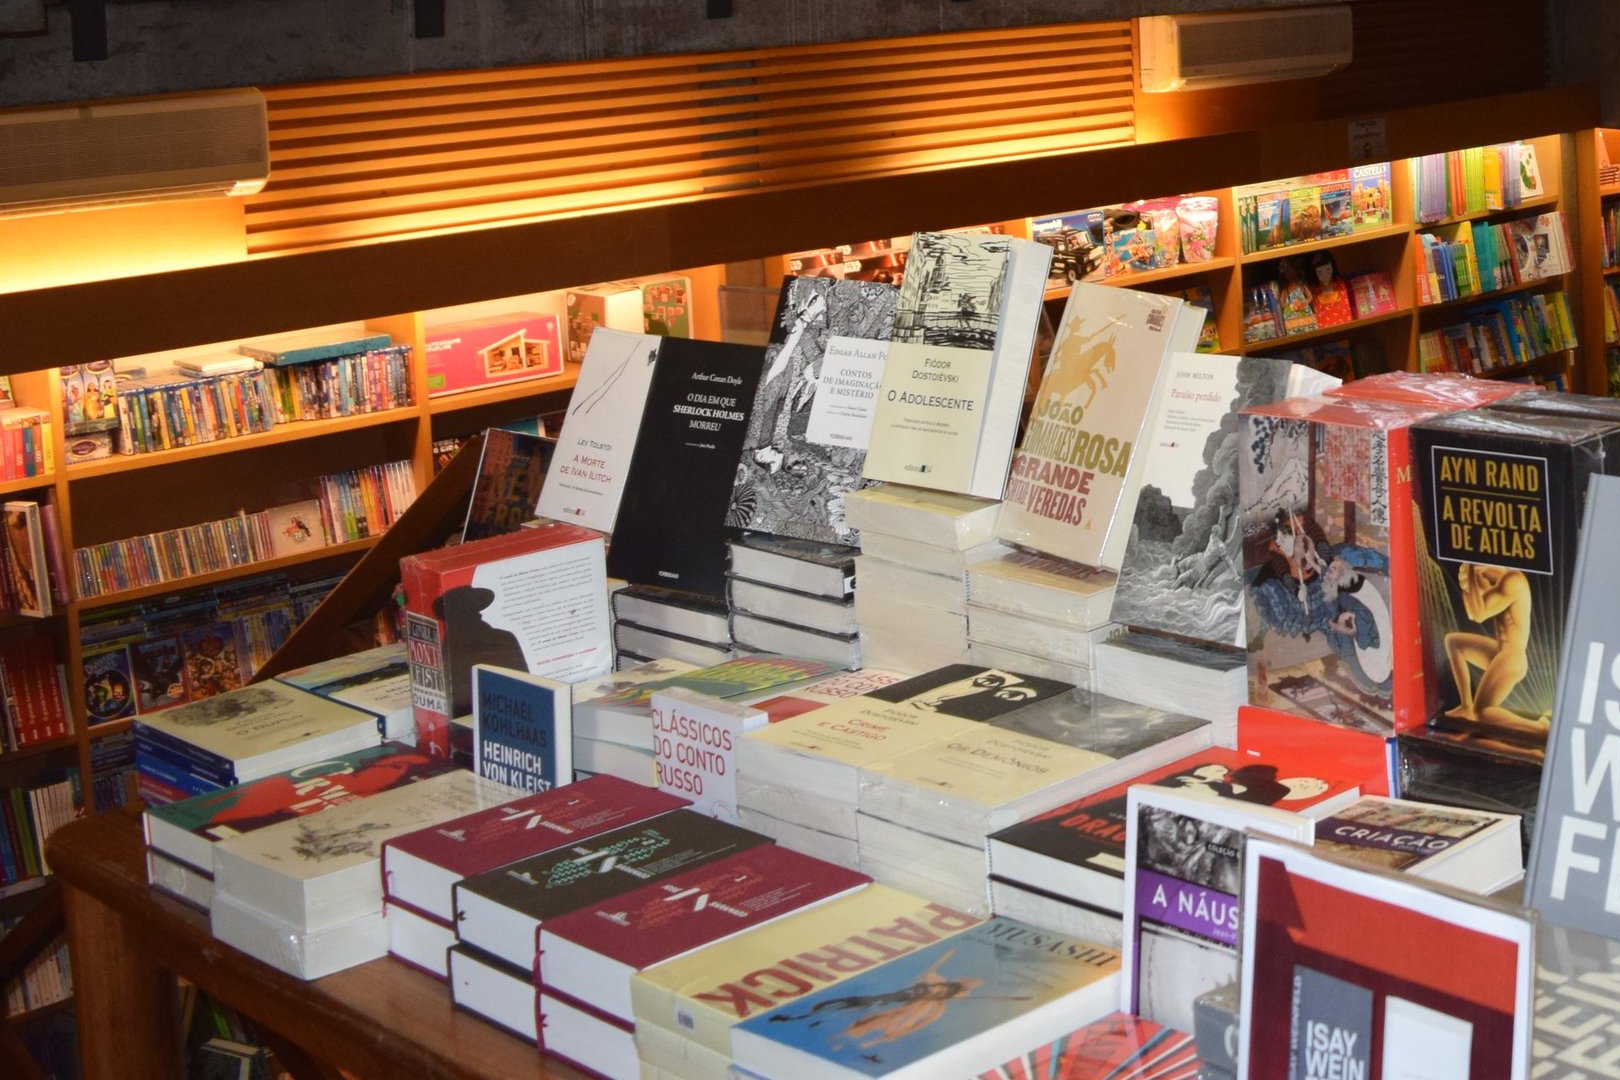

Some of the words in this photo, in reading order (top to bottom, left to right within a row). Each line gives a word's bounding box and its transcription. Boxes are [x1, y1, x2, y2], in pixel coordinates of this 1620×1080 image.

[822, 376, 834, 384] DE
[840, 368, 873, 379] CONTOS
[1175, 371, 1191, 380] JOHN
[1192, 372, 1214, 381] MILTON
[687, 393, 694, 401] O
[694, 394, 707, 403] DIA
[707, 395, 720, 404] EM
[720, 397, 736, 408] QUE
[830, 387, 835, 395] E
[836, 387, 874, 399] MISTÉRIO
[887, 389, 896, 402] O
[900, 391, 974, 411] ADOLESCENTE
[1196, 391, 1222, 403] perdido
[672, 404, 712, 417] SHERLOCK
[712, 410, 744, 421] HOLMES
[689, 420, 721, 431] MORREU
[1038, 399, 1085, 425] JOÃO
[573, 455, 579, 463] A
[580, 456, 606, 469] MORTE
[1069, 430, 1132, 478] ROSA
[560, 465, 569, 475] DE
[570, 466, 587, 478] IVAN
[588, 471, 611, 484] ILITCH
[1011, 454, 1095, 495] GRANDE
[1440, 456, 1477, 484] AYN
[1486, 462, 1539, 492] RAND
[1025, 485, 1088, 526] VEREDAS
[1442, 495, 1455, 521] A
[1460, 498, 1542, 533] REVOLTA
[1452, 524, 1473, 551] DE
[1480, 528, 1536, 560] ATLAS
[482, 691, 534, 723] MICHAEL
[482, 712, 547, 748] KOHLHAAS
[651, 709, 732, 751] CLÁSSICOS
[828, 724, 888, 741] CASTIGO
[848, 719, 891, 732] CRIME
[484, 740, 542, 774] HEINRICH
[653, 735, 672, 759] DO
[676, 744, 725, 776] CONTO
[970, 746, 1048, 774] DEMÔNIOS
[483, 761, 508, 786] VON
[510, 772, 551, 794] KLEIST
[656, 761, 704, 796] RUSSO
[1334, 824, 1450, 851] CRIAÇÃO
[1152, 884, 1167, 908] A
[1179, 889, 1239, 930] NÁUS
[693, 902, 980, 1017] PATRICK
[987, 922, 1121, 967] MUSASHI
[1305, 1020, 1358, 1056] ISAY
[1304, 1049, 1365, 1080] WEIN
